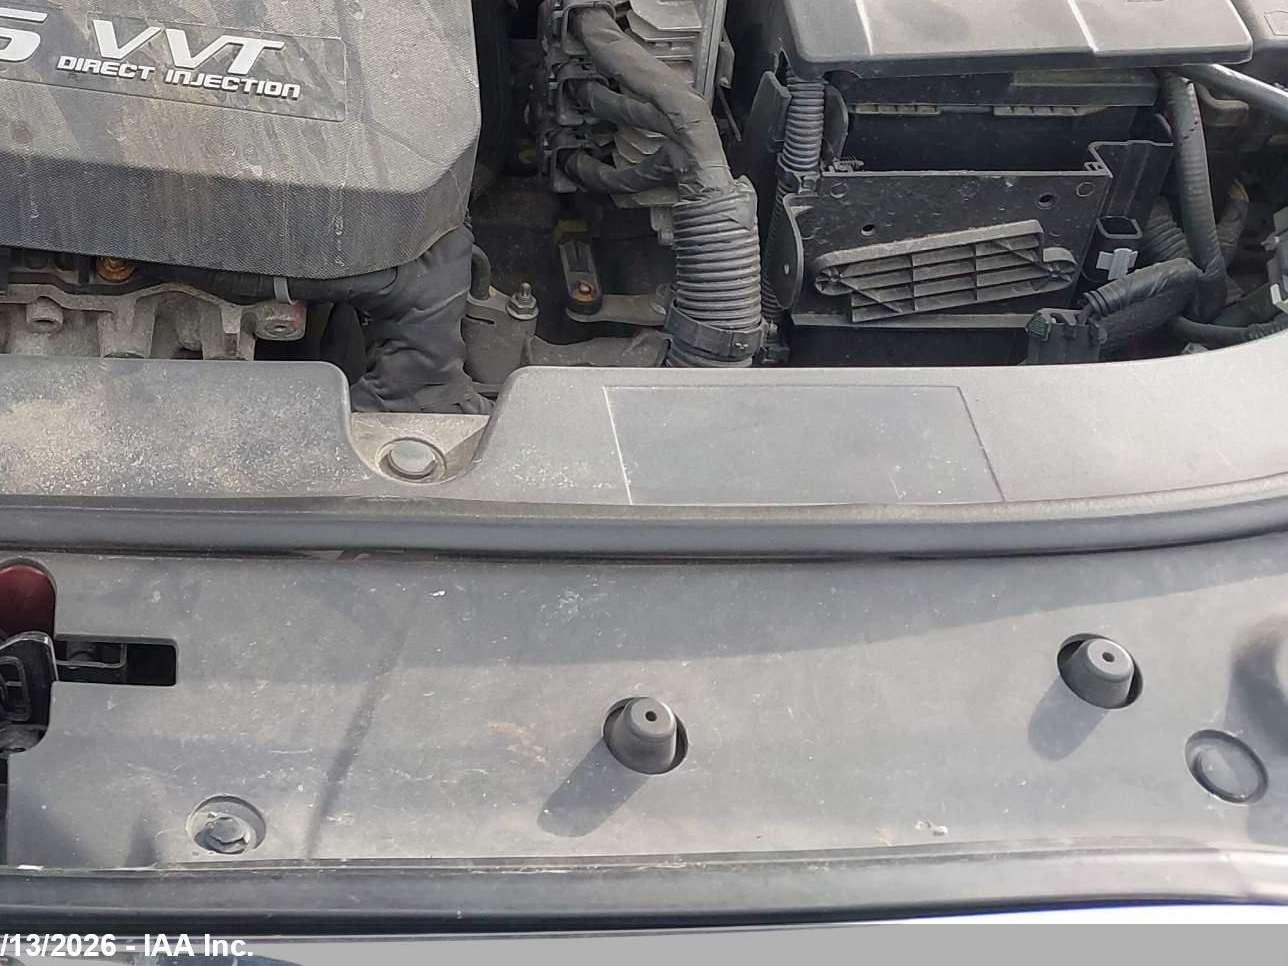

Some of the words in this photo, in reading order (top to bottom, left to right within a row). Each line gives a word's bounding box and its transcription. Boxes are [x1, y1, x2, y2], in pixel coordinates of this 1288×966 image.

[92, 19, 286, 75] VVT
[56, 56, 155, 82] DIRECT
[164, 68, 301, 100] INJECTION
